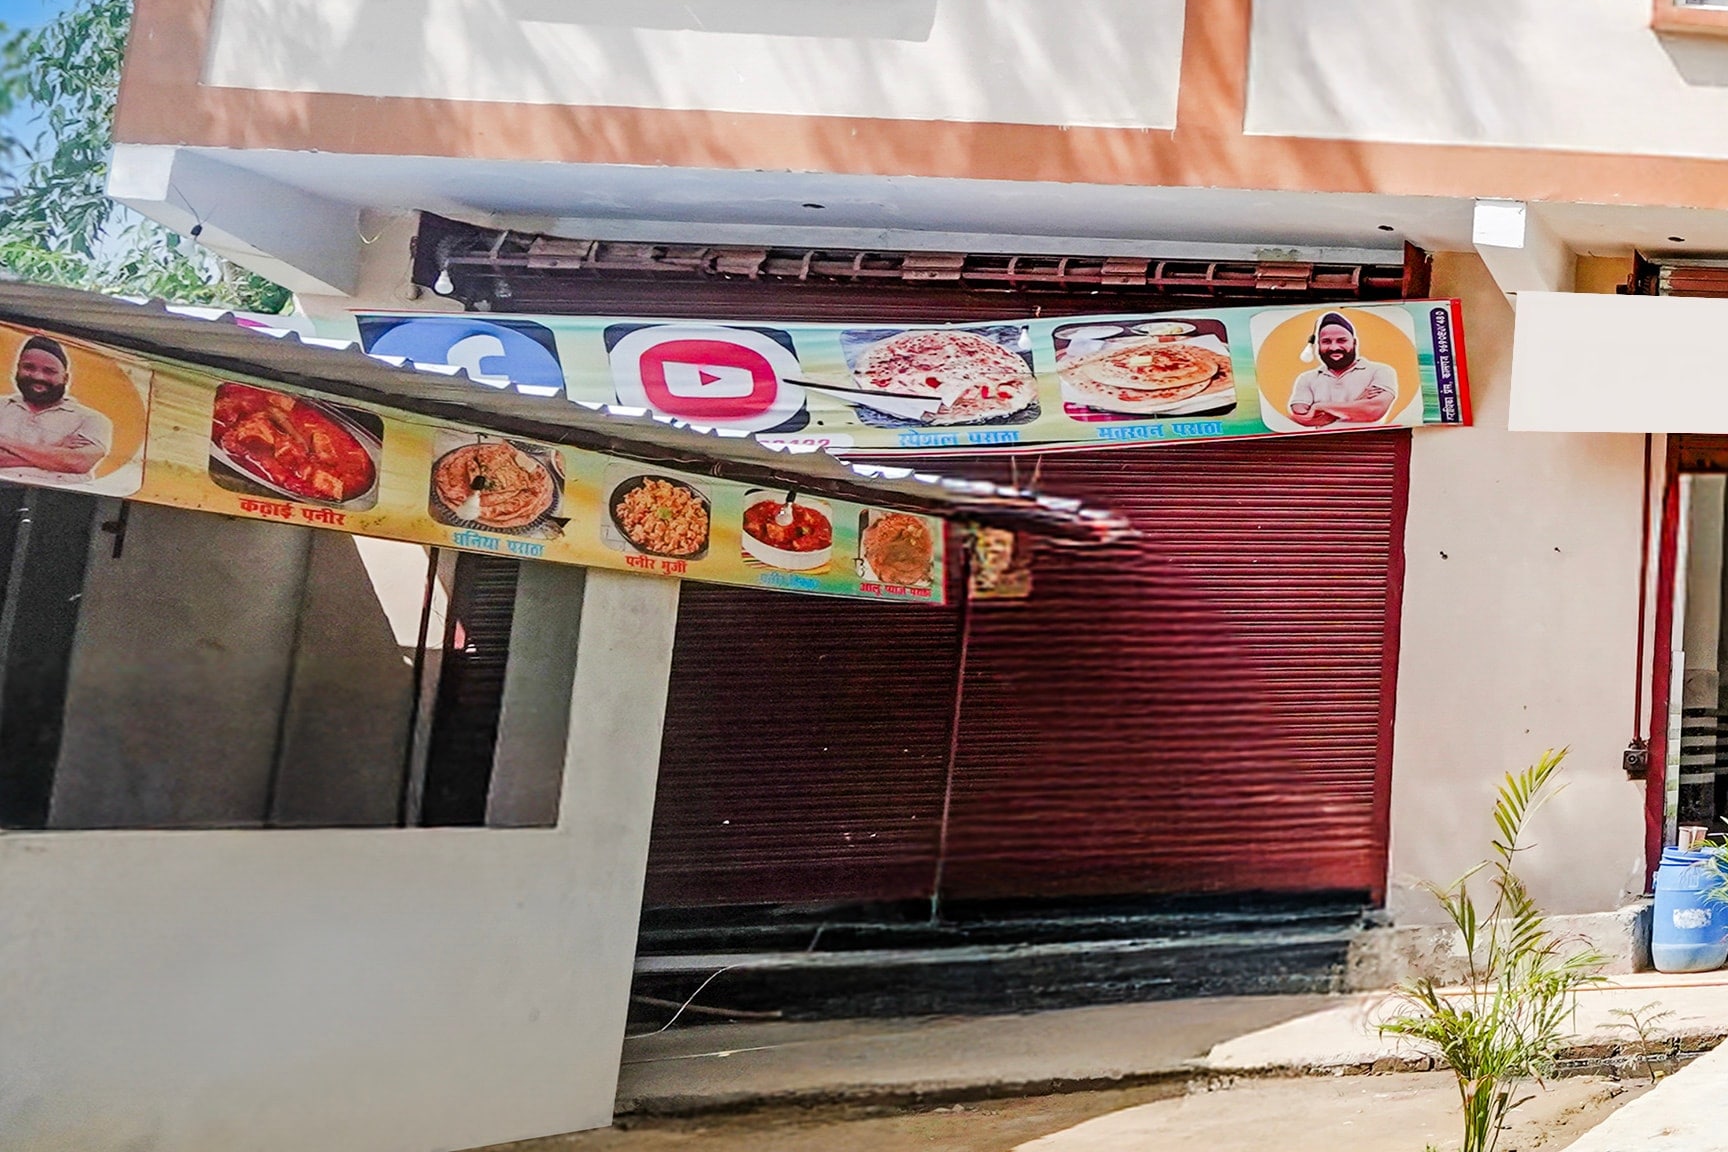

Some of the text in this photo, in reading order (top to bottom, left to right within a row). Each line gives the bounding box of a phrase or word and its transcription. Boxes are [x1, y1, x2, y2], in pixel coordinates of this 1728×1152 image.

[897, 428, 959, 448] स्पेशल
[301, 507, 346, 526] पनीर
[624, 553, 656, 570] पनीर
